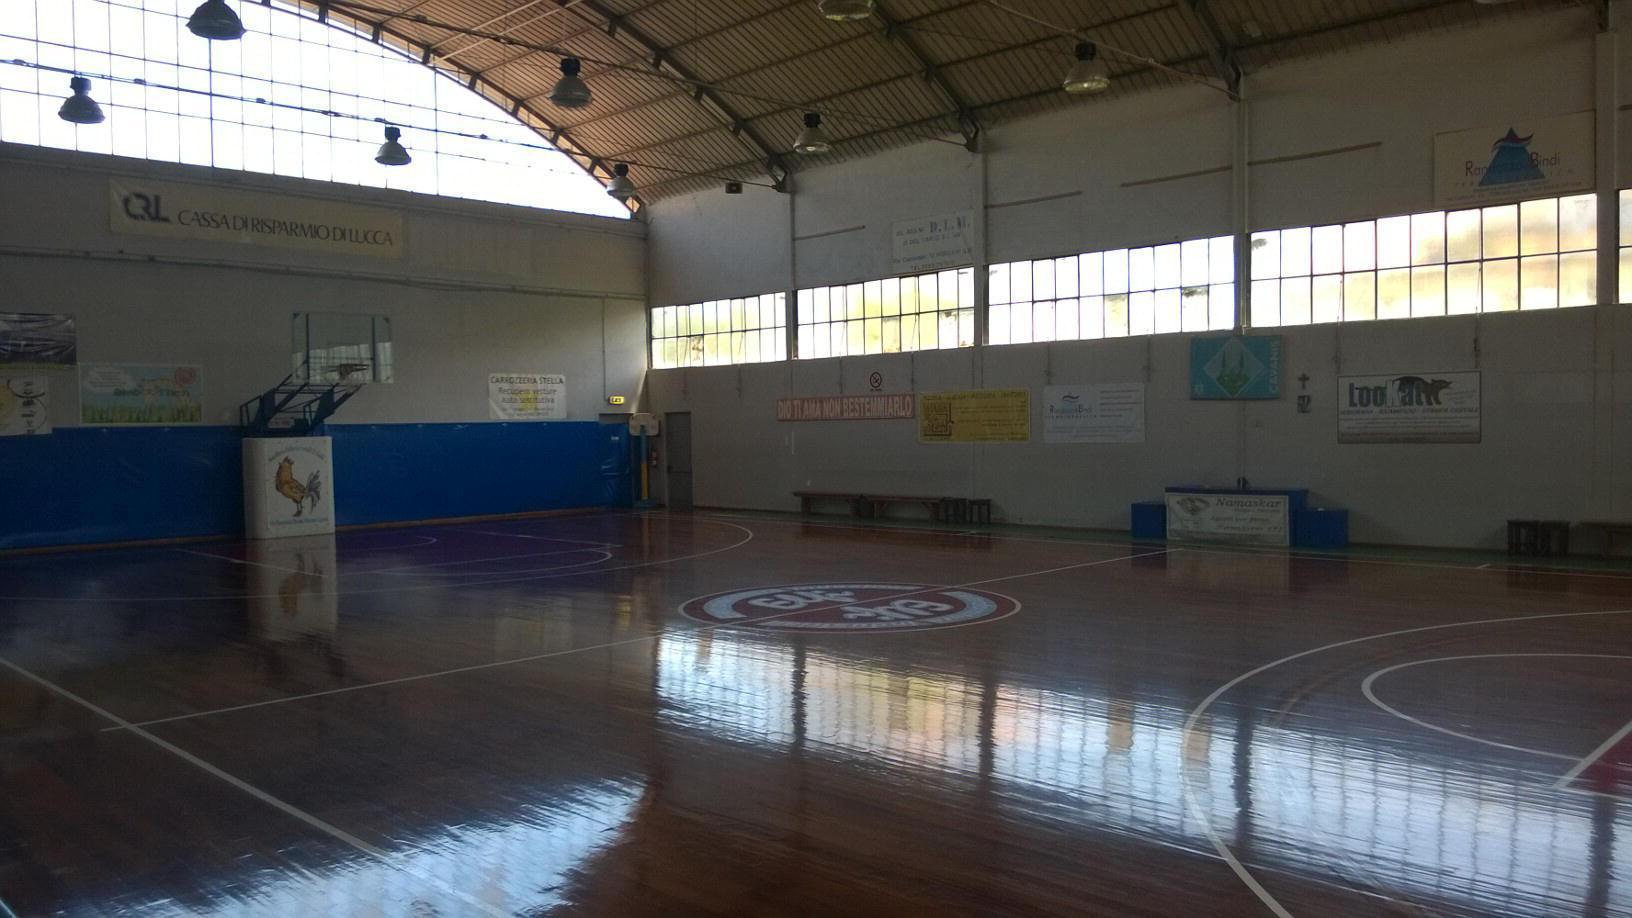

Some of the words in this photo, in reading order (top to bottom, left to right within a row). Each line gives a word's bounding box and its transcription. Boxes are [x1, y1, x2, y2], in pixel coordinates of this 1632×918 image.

[1530, 151, 1560, 169] Bindi
[177, 209, 231, 231] CASSA
[232, 214, 249, 233] DI
[250, 217, 331, 241] RISPARMIO
[332, 225, 347, 242] DI
[348, 227, 394, 247] LUCCA
[490, 375, 538, 385] CARROZZERIA
[539, 376, 565, 385] STELLA
[778, 399, 793, 419] DIO
[793, 399, 802, 419] TI
[803, 399, 822, 419] AMA
[823, 398, 842, 418] NON
[843, 395, 913, 418] BESTEMMIARLO
[1215, 497, 1282, 509] Namaskar
